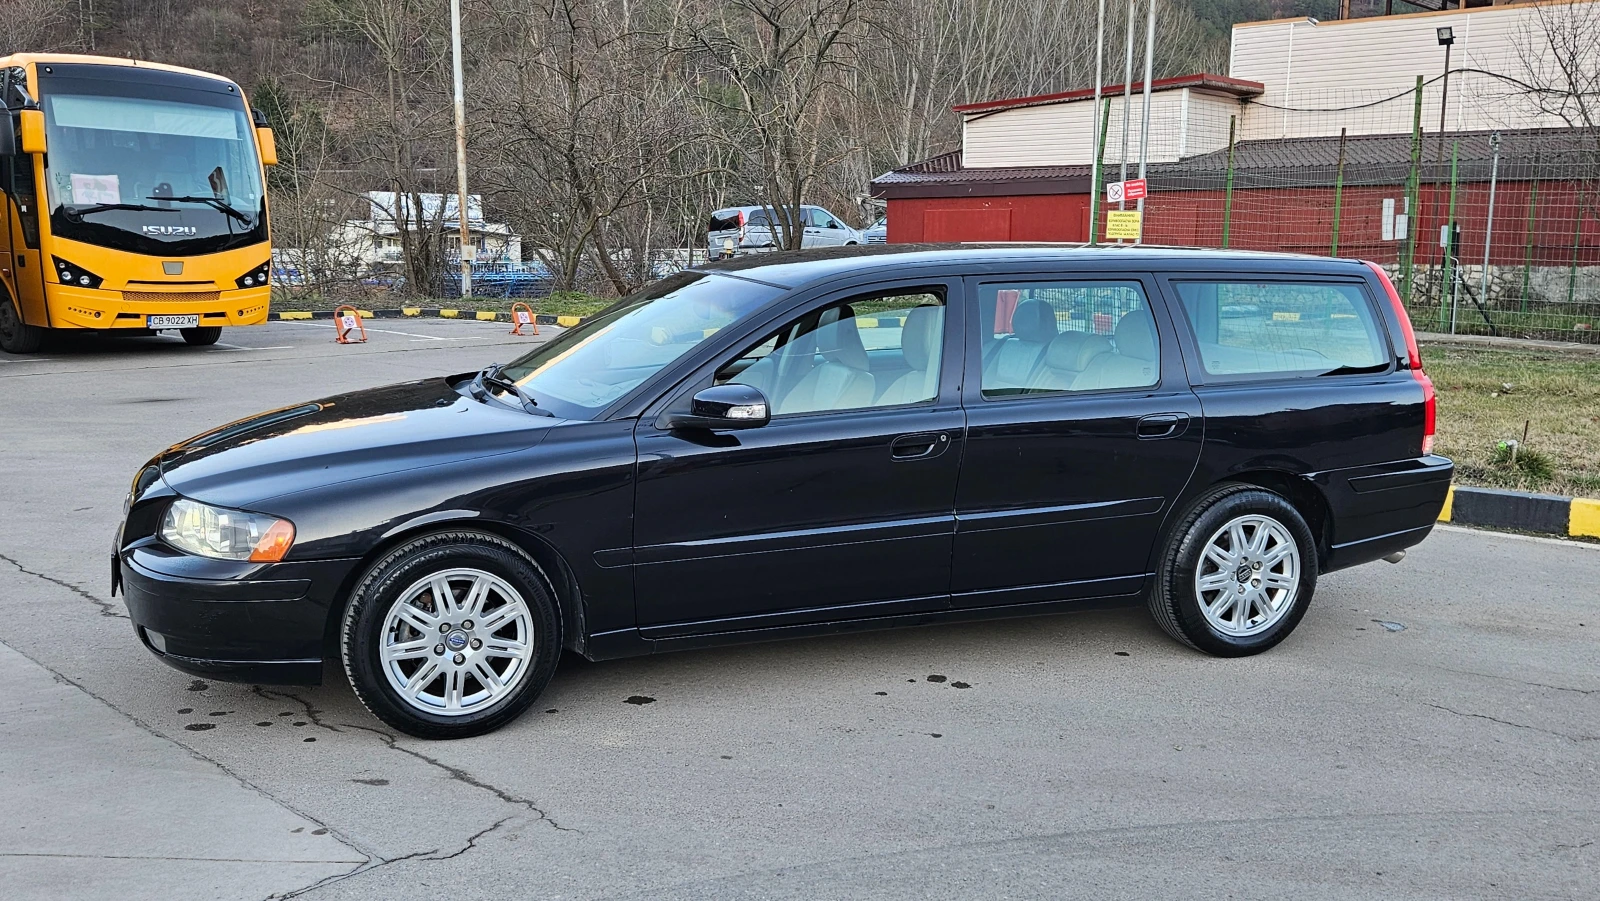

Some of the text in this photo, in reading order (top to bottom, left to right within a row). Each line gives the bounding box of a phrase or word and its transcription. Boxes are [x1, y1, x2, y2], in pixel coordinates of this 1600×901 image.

[142, 225, 197, 236] ISUZU
[153, 316, 198, 325] CB 9022 XH
